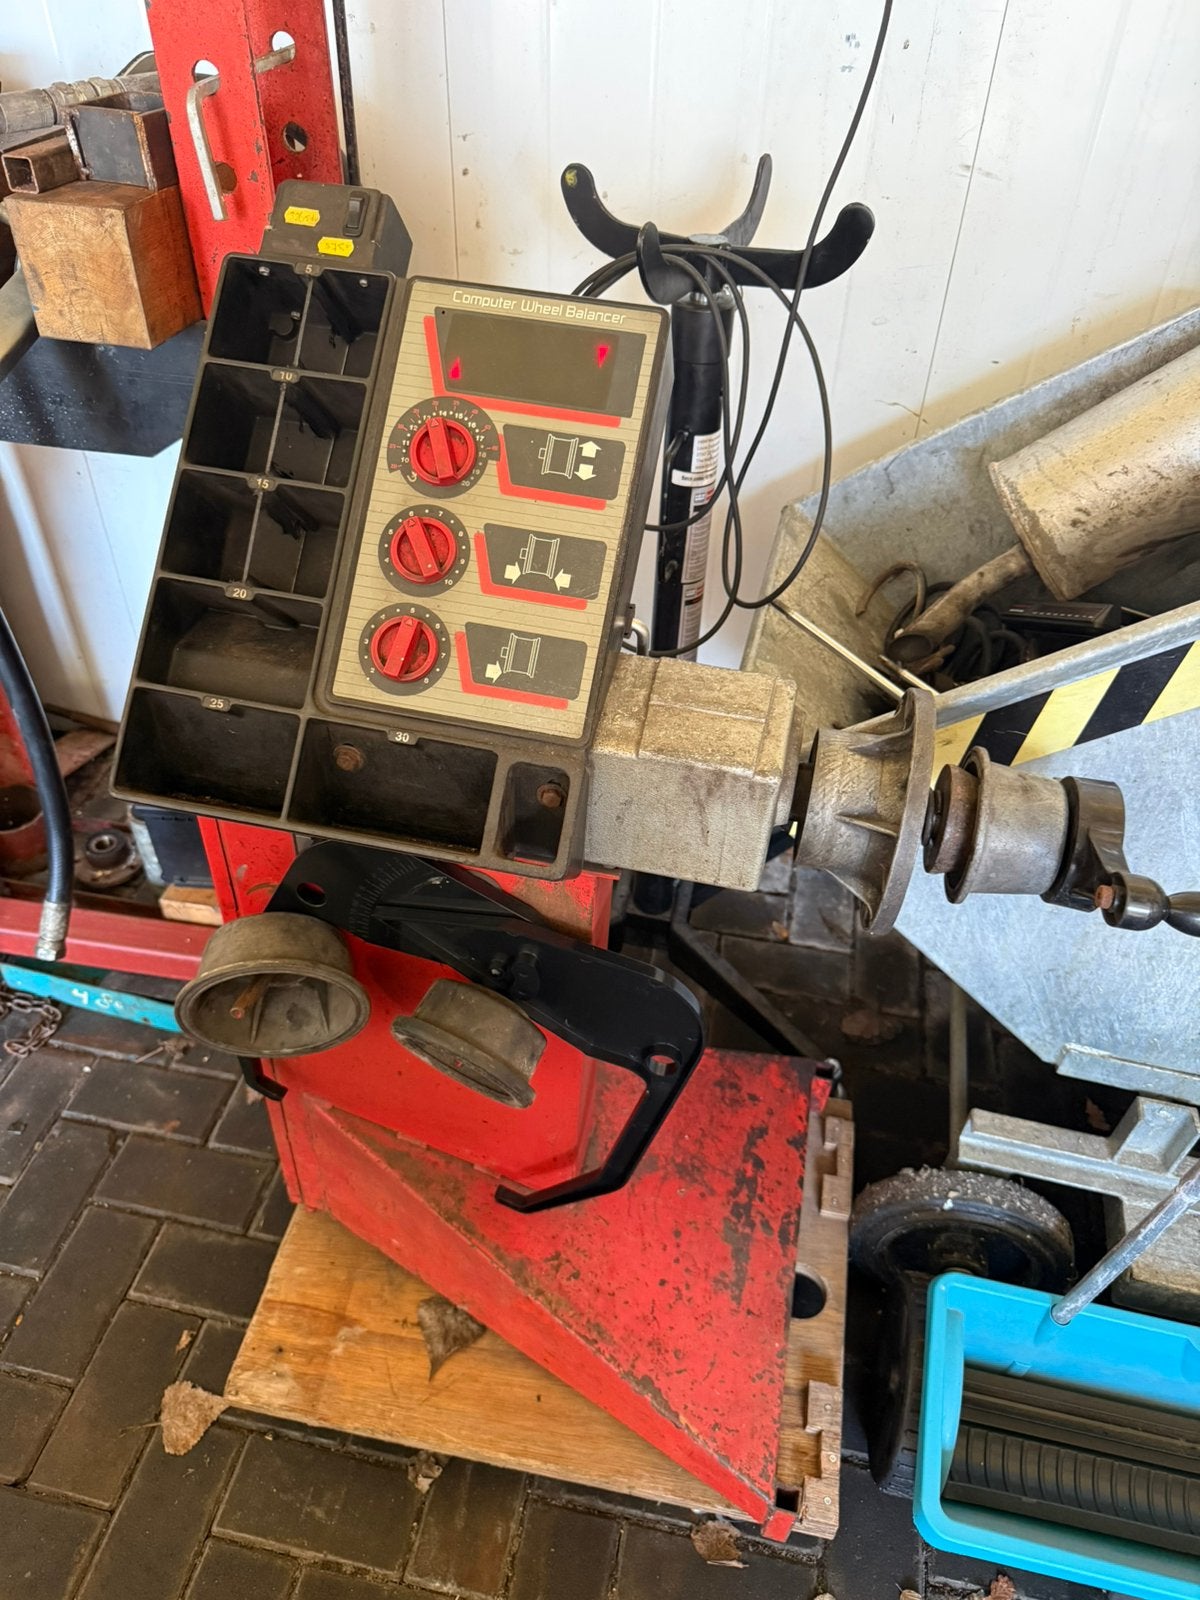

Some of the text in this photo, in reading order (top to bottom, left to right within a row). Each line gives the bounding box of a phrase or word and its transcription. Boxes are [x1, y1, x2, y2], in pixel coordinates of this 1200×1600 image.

[304, 264, 313, 273] 5
[452, 289, 627, 324] Computer Wheel Balancer
[280, 371, 292, 381] 10
[257, 478, 270, 489] 15
[232, 587, 247, 599] 20
[209, 698, 224, 709] 25
[394, 731, 410, 743] 30
